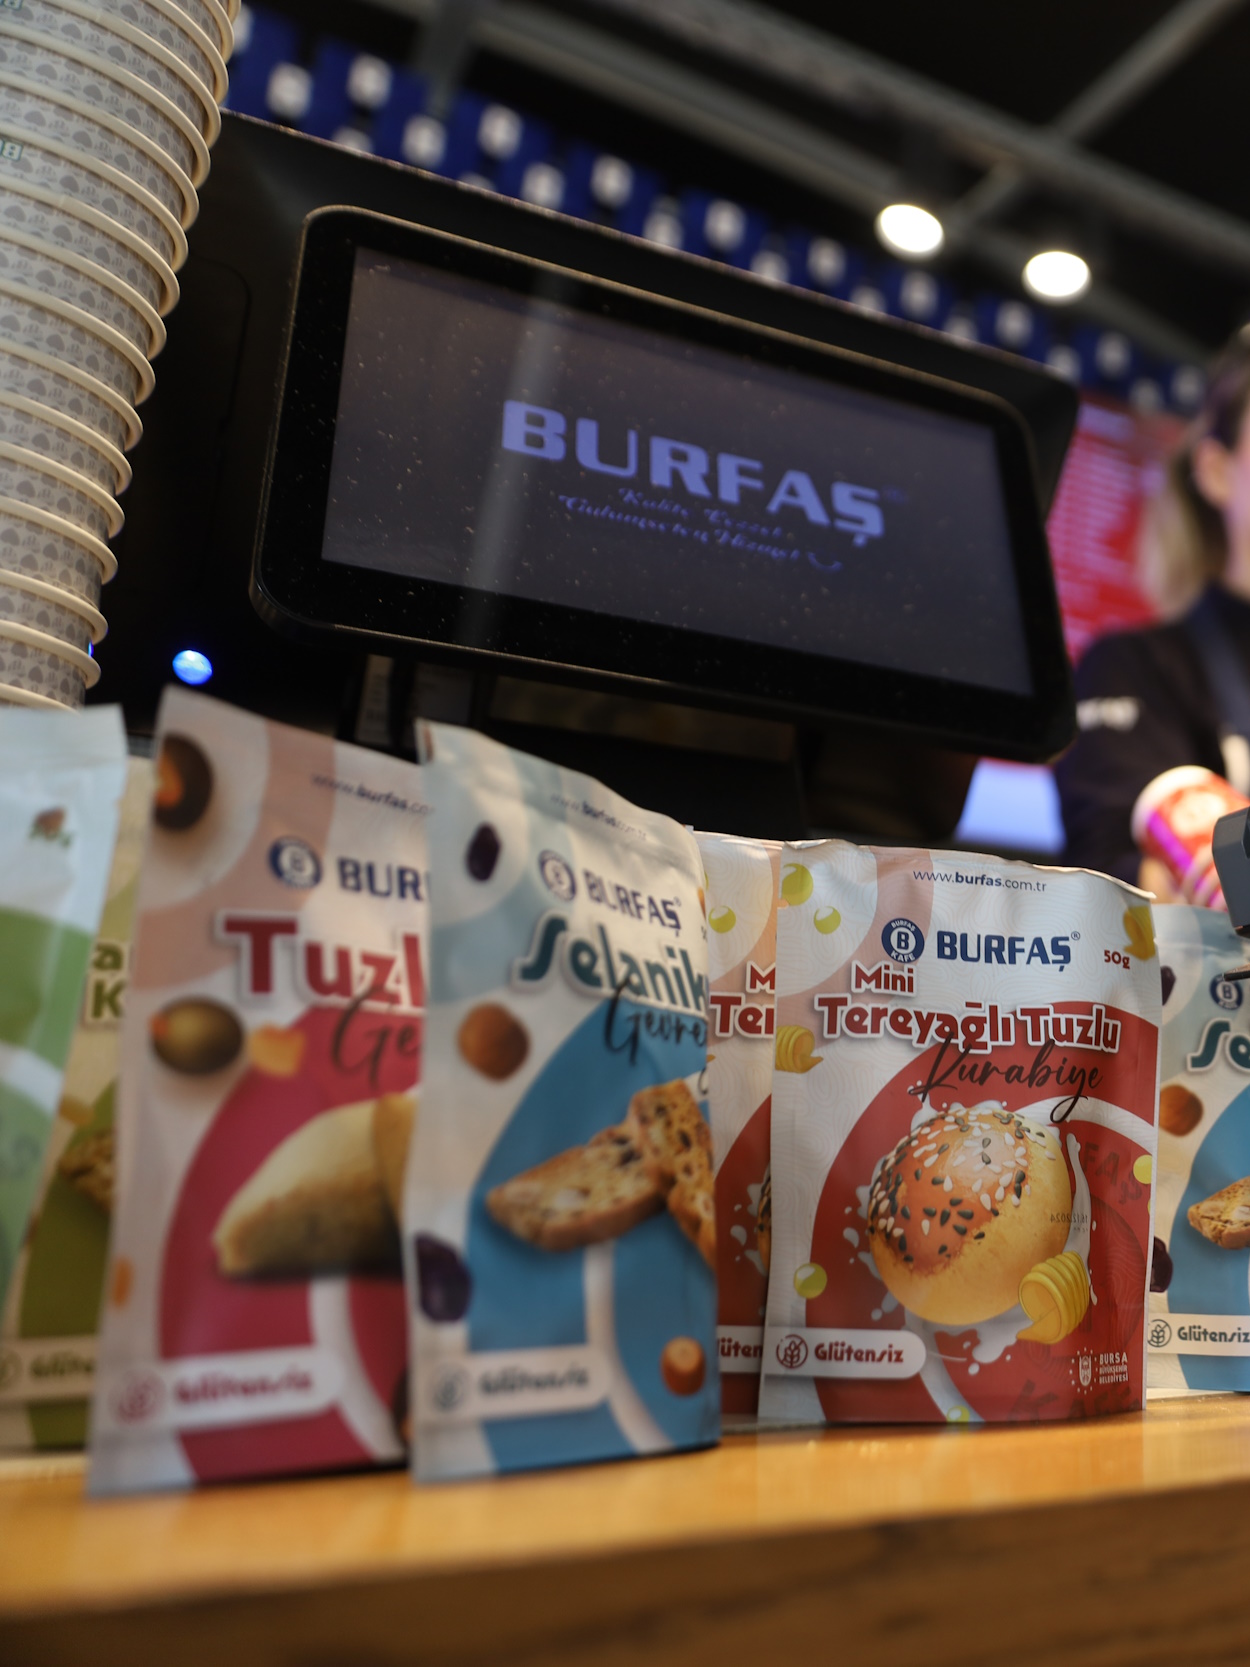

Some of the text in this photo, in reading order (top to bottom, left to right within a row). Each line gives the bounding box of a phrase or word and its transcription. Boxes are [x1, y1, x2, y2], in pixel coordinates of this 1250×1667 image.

[502, 399, 883, 547] BURFAŞ
[912, 869, 1048, 893] www.burfas.com.tr
[896, 930, 910, 951] B
[936, 929, 1072, 972] BURFAŞ
[890, 950, 916, 962] KAFE
[1103, 949, 1131, 970] 50g
[854, 962, 915, 994] Mini
[817, 997, 1118, 1051] Tereyağlı Tuzlu
[907, 1031, 1105, 1124] Kurabiye
[1177, 1325, 1250, 1343] Glütensiz
[814, 1341, 904, 1364] Glütensiz
[1099, 1351, 1129, 1365] BURSA
